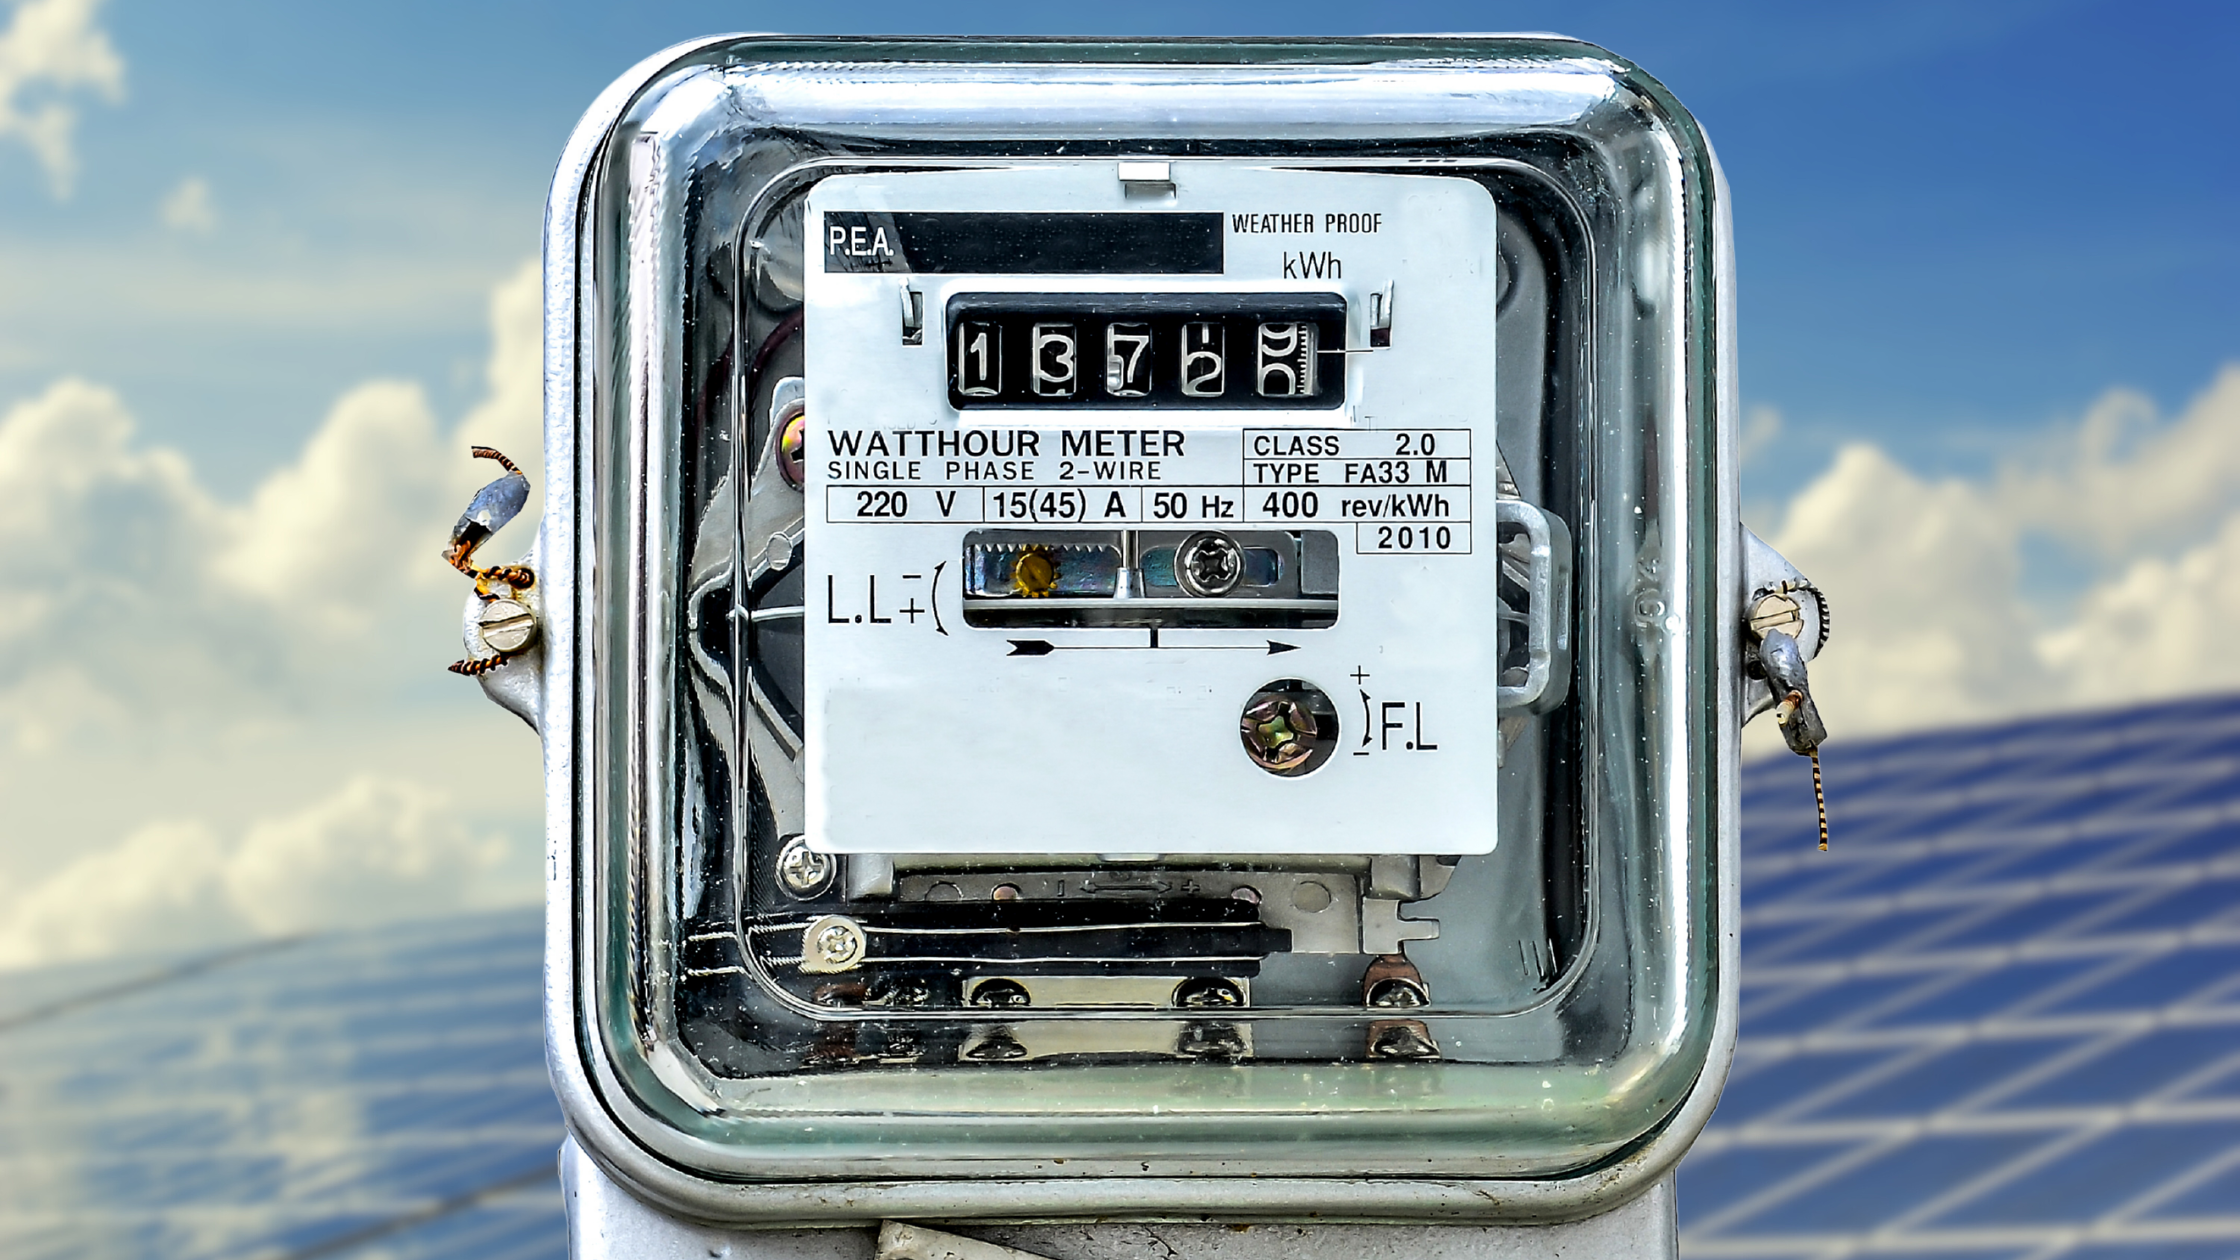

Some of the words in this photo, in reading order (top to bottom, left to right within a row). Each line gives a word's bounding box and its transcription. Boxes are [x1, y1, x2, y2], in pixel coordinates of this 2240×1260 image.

[1231, 213, 1314, 234] WEATHER
[1325, 213, 1382, 234] PROOF
[1283, 251, 1342, 280] kWh
[828, 430, 1040, 457] WATTHOUR
[1061, 430, 1185, 457] METER
[1253, 435, 1340, 456] CLASS
[1395, 434, 1436, 455] 2.0
[828, 461, 921, 481] SINGLE
[946, 461, 1035, 481] PHASE
[1059, 461, 1161, 481] 2-WIRE
[1253, 462, 1320, 484] TYPE
[1344, 462, 1410, 484] FA33
[1426, 461, 1447, 483] M
[856, 491, 908, 518] 220
[936, 492, 957, 518] V
[993, 490, 1086, 522] 15(45)
[1104, 492, 1127, 518] A
[1153, 492, 1188, 519] 50
[1201, 496, 1234, 519] Hz
[1262, 492, 1319, 519] 400
[1341, 494, 1449, 518] rev/kWh
[1378, 526, 1451, 550] 2010
[1381, 701, 1438, 751] F.L
